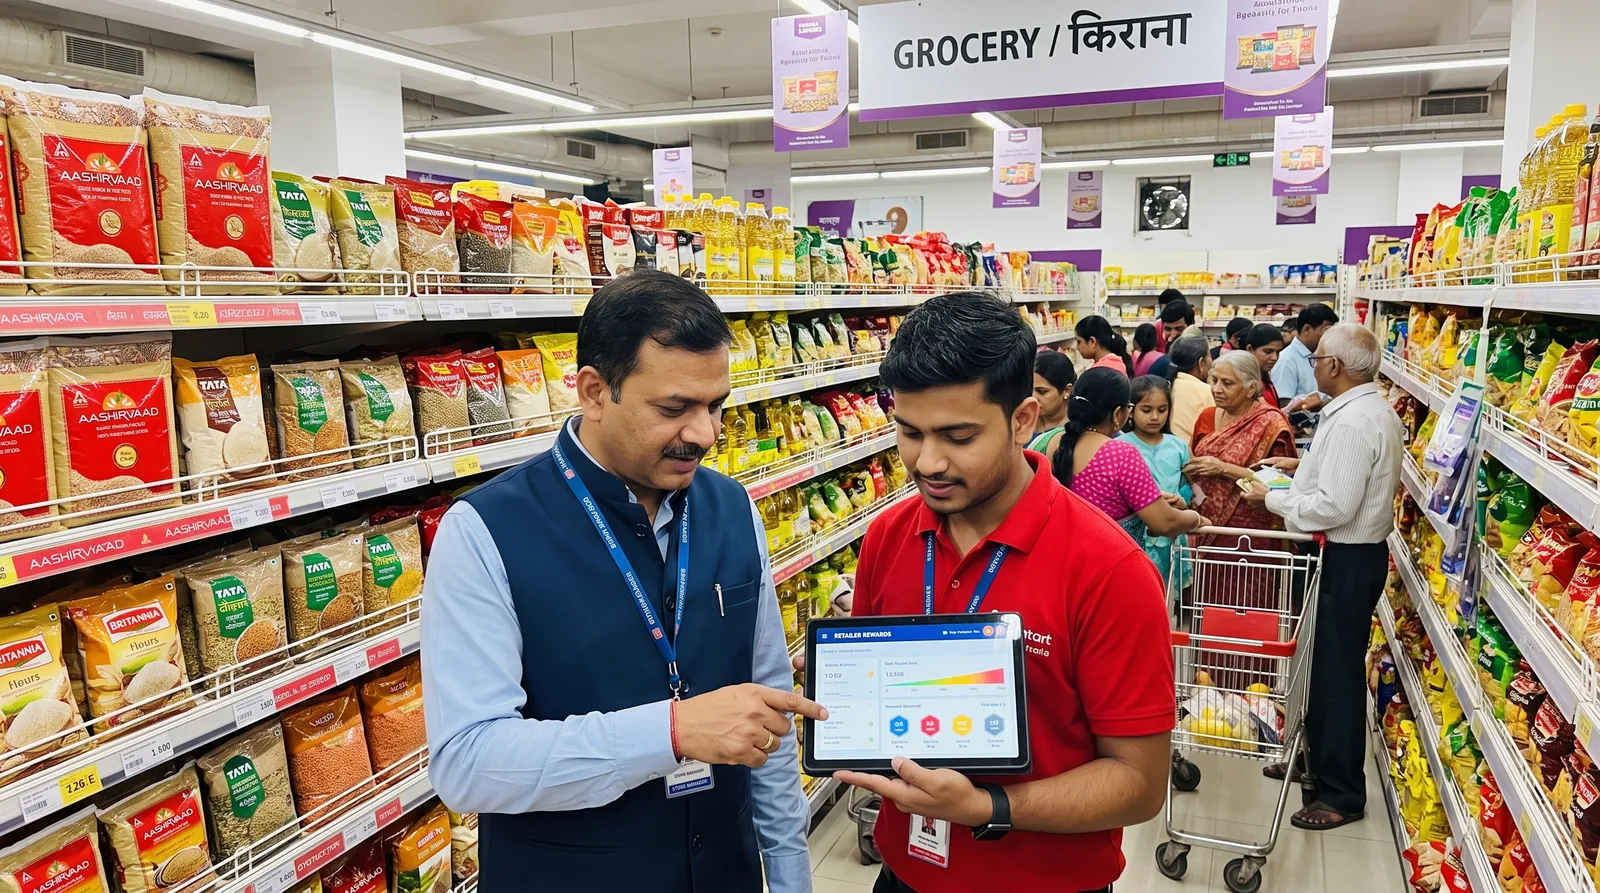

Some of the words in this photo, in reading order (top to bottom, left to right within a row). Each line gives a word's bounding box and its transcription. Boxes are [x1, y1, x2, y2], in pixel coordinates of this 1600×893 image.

[893, 26, 1041, 70] GROCERY
[1048, 24, 1061, 57] /
[1067, 9, 1193, 55] किराना
[59, 169, 142, 188] AASHIRVAAD
[194, 178, 264, 195] AASHIRVAAD
[278, 190, 308, 201] TATA
[349, 201, 371, 212] TATA
[198, 379, 229, 390] TATA
[78, 407, 159, 425] AASHIRVAAD
[165, 514, 232, 538] AASHIRVAAD
[369, 543, 393, 554] TATA
[305, 561, 332, 574] TATA
[214, 585, 246, 599] TATA
[108, 608, 162, 632] BRITANNIA
[226, 762, 253, 780] TATA
